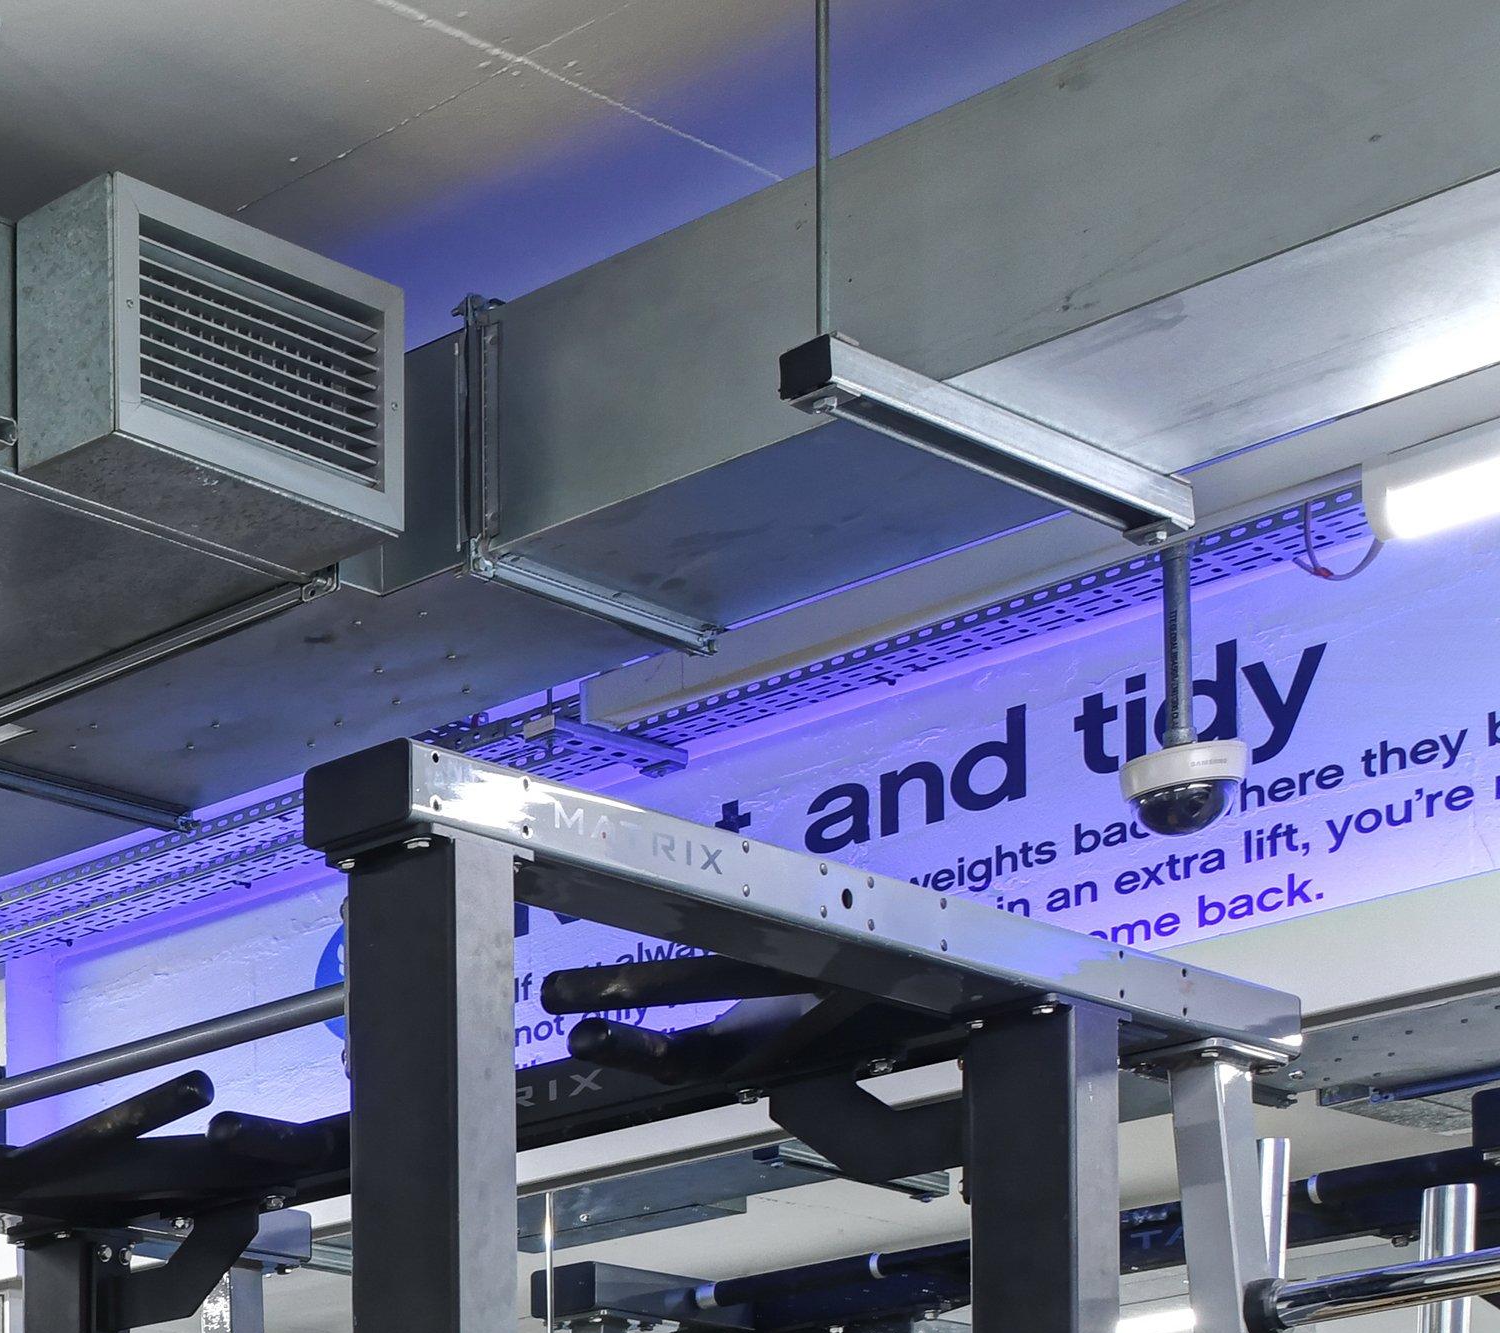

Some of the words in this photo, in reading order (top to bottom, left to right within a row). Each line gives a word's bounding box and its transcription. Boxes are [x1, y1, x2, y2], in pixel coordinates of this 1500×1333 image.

[804, 703, 1028, 854] and
[1074, 638, 1328, 775] tidy
[1361, 728, 1469, 778] they
[553, 800, 724, 876] MATRIX
[1046, 879, 1098, 914] an
[1114, 848, 1226, 896] extra
[1243, 822, 1311, 865] lift,
[1326, 783, 1474, 853] you're
[1197, 873, 1325, 928] back.
